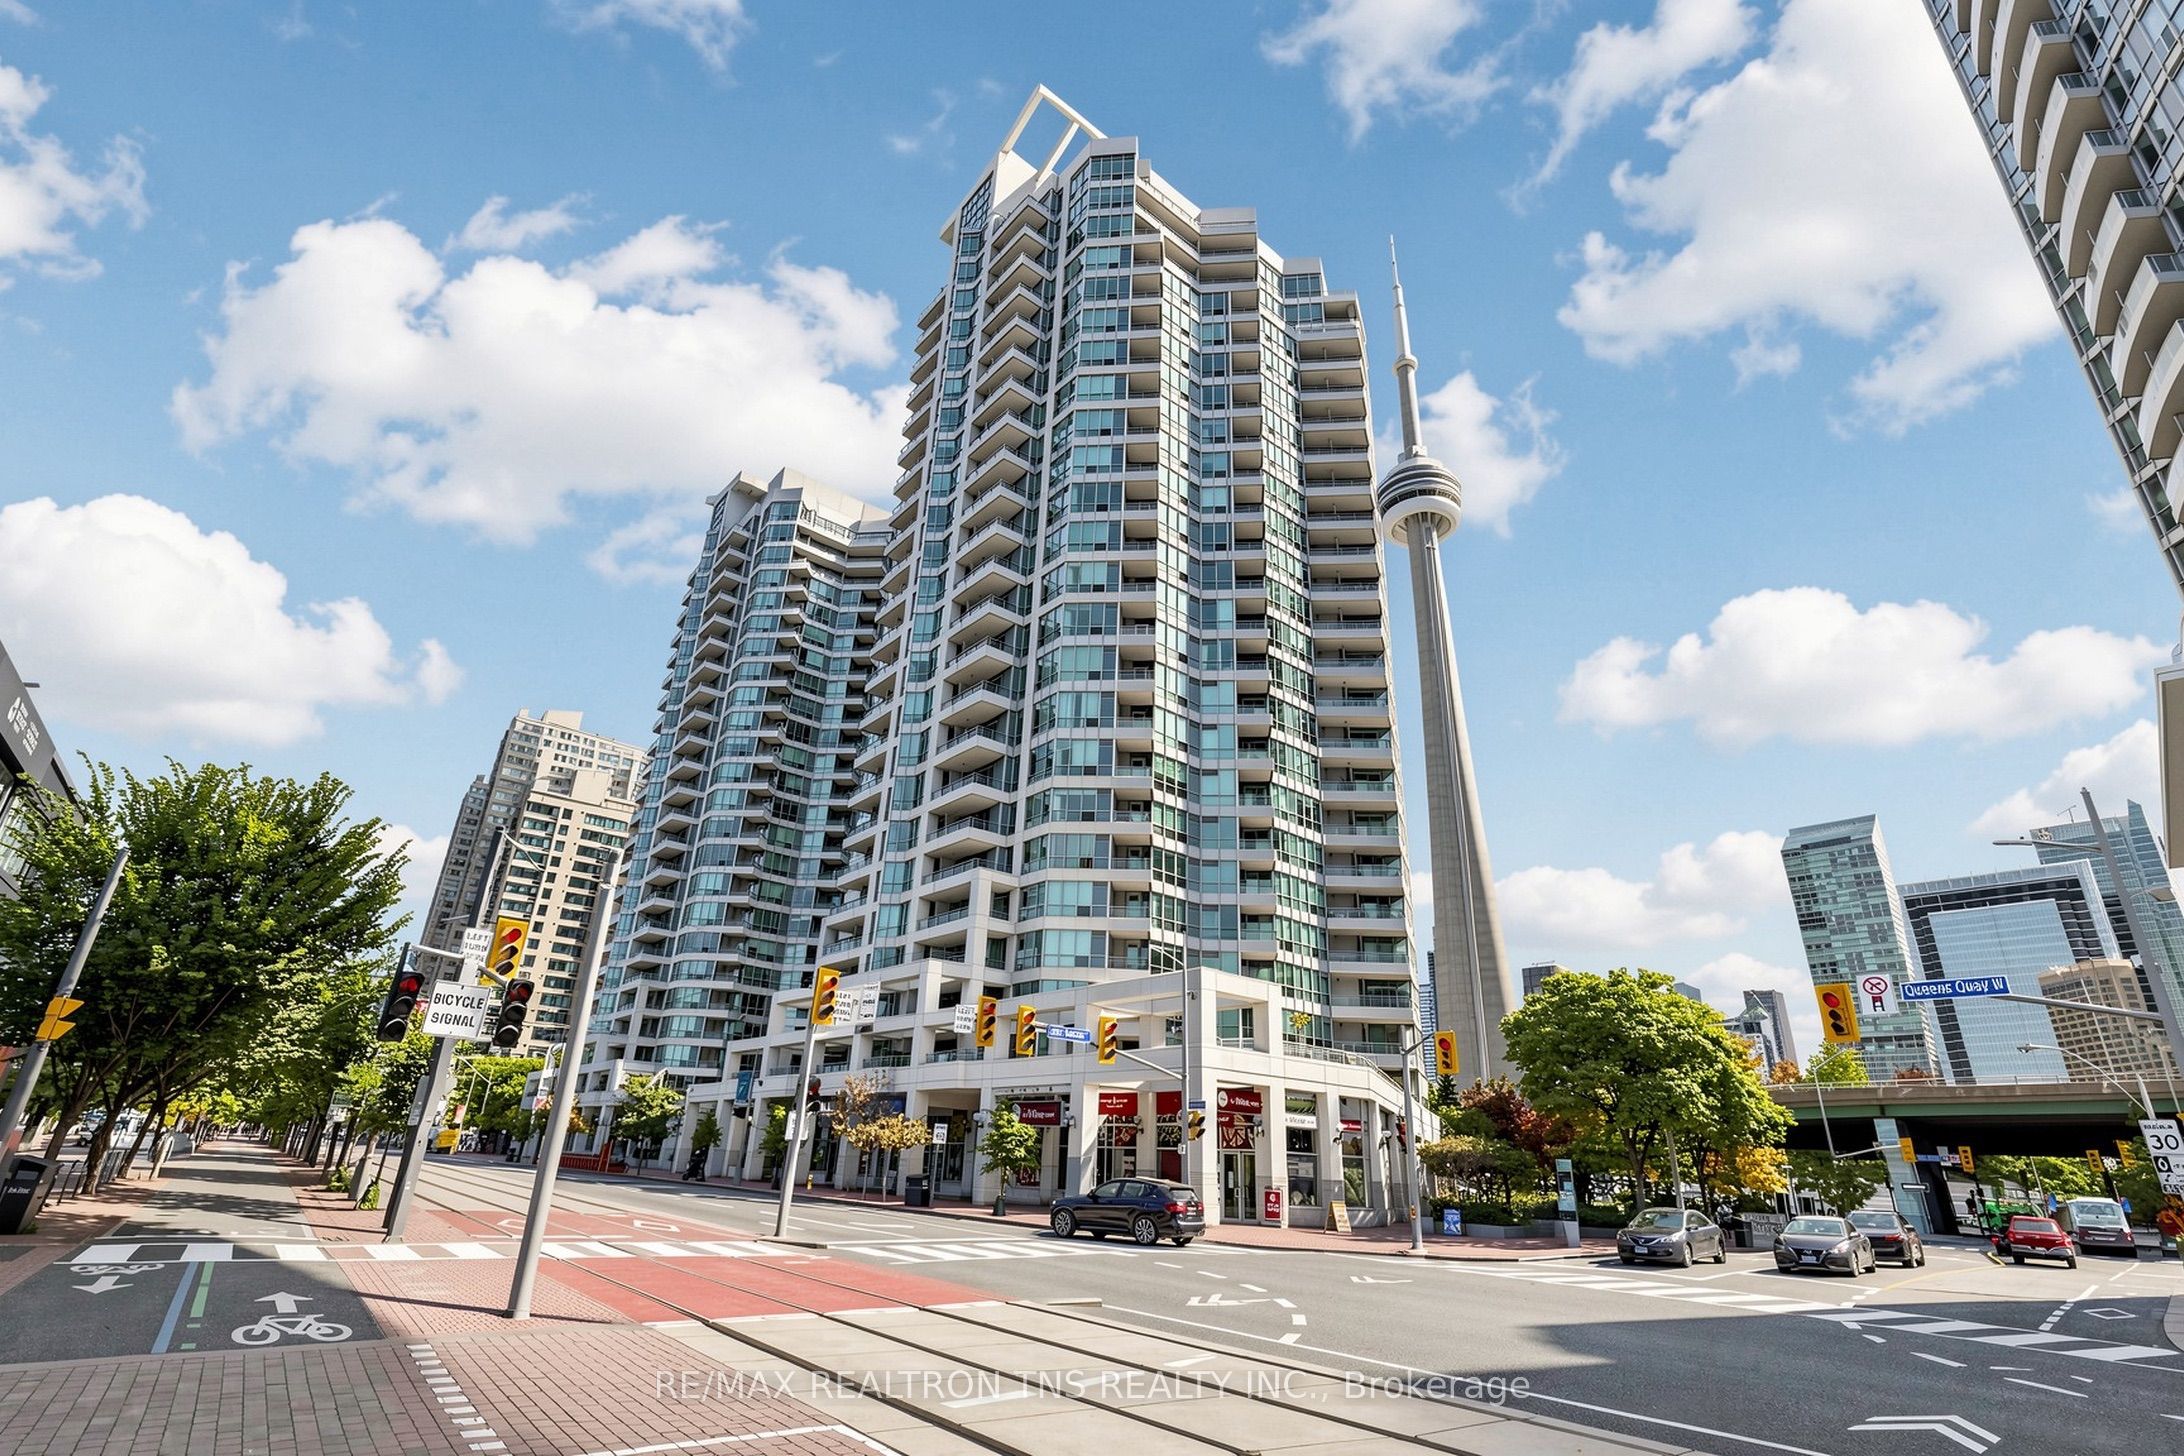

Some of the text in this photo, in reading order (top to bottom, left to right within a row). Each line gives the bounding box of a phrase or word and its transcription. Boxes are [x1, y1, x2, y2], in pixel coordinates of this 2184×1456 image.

[1904, 977, 2004, 997] Queens Quay W
[433, 993, 485, 1010] BICYCLE
[430, 1012, 475, 1028] SIGNAL
[2149, 1134, 2179, 1150] 30
